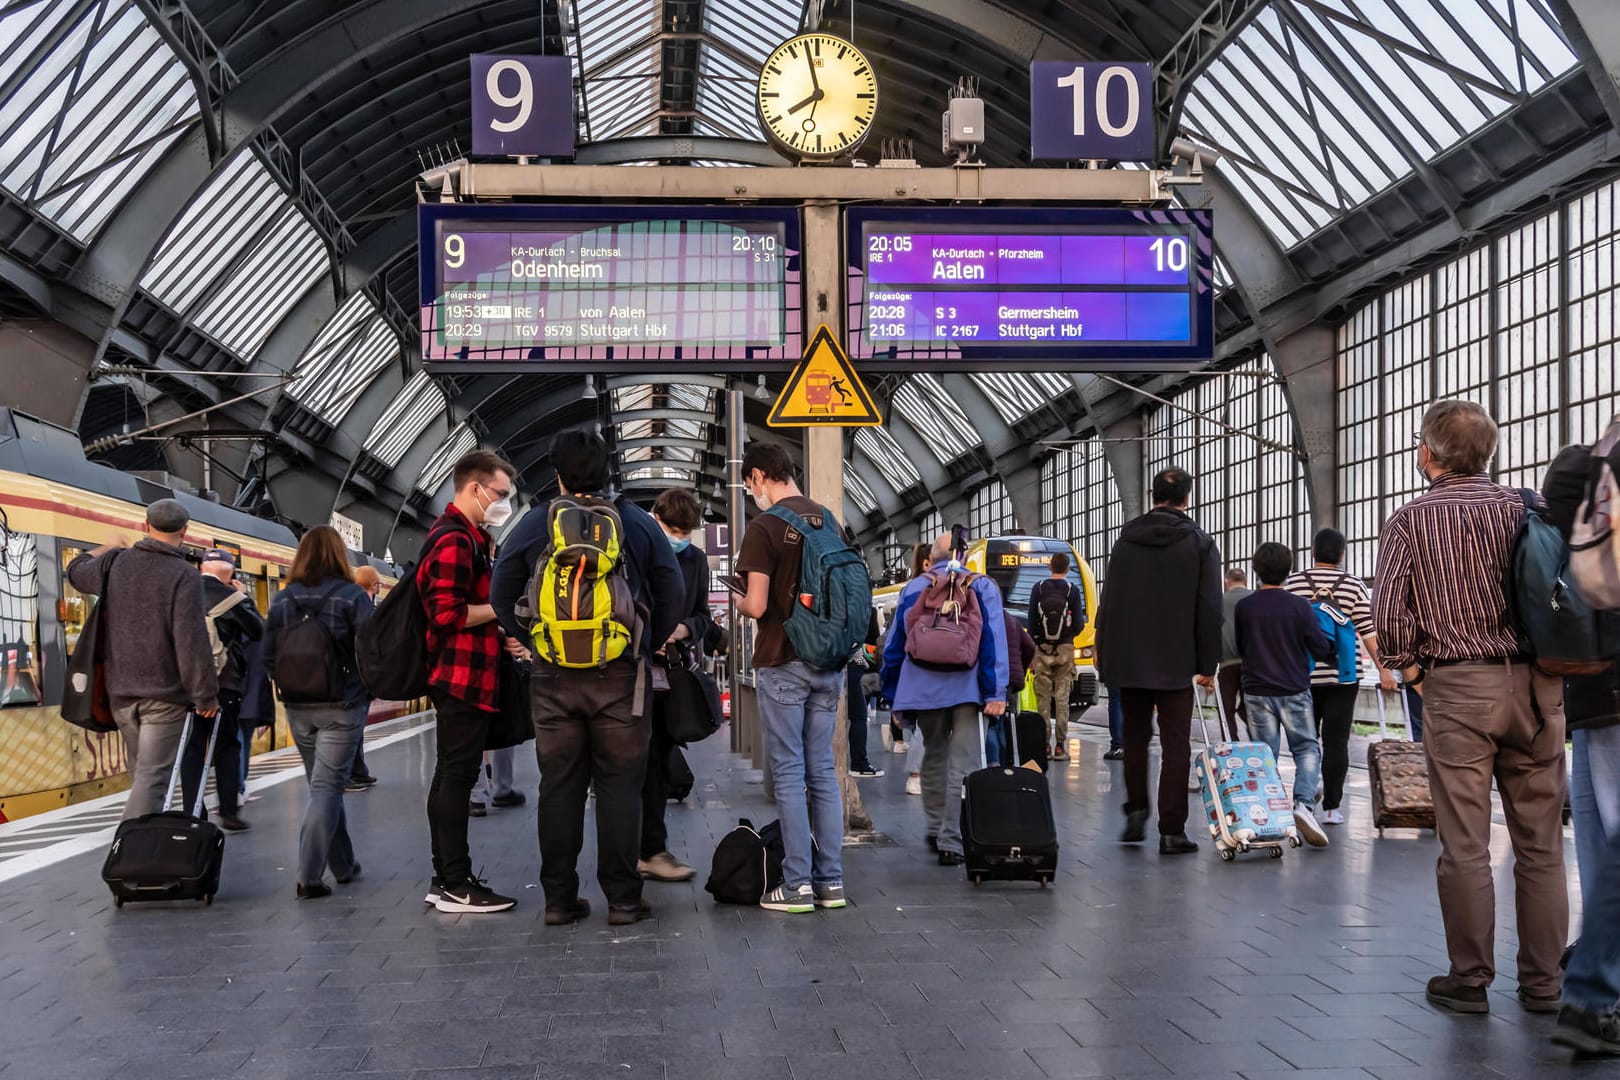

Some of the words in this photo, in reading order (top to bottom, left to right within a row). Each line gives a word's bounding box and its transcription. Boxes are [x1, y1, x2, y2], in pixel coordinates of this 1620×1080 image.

[486, 59, 534, 133] 9
[1057, 66, 1140, 138] 10
[444, 234, 465, 268] 9
[511, 247, 565, 257] KA-Durlach
[580, 247, 622, 257] Bruchsal
[732, 236, 775, 251] 20:10
[869, 235, 912, 252] 20:05
[754, 252, 761, 262] S
[764, 252, 775, 262] 31
[869, 252, 884, 263] IRE
[887, 252, 893, 263] 1
[932, 248, 985, 259] KA-Durlach
[998, 248, 1044, 259] Pforzheim
[1149, 238, 1187, 272] 10
[511, 260, 603, 278] Odenheim
[932, 261, 985, 279] Aalen
[446, 305, 482, 318] 19:53
[514, 306, 533, 318] IRE
[538, 306, 545, 318] 1
[580, 308, 602, 318] von
[609, 305, 645, 319] Aalen
[869, 306, 905, 319] 20:28
[936, 307, 945, 319] S
[949, 307, 956, 319] 3
[998, 306, 1079, 319] Germersheim
[445, 323, 482, 337] 20:29
[515, 325, 539, 337] TGV
[544, 325, 573, 337] 9579
[580, 323, 639, 340] Stuttgart
[645, 323, 668, 337] Hbf
[869, 323, 905, 337] 21:06
[936, 325, 947, 337] IC
[951, 325, 979, 337] 2167
[998, 323, 1055, 340] Stuttgart
[1061, 324, 1083, 337] Hbf
